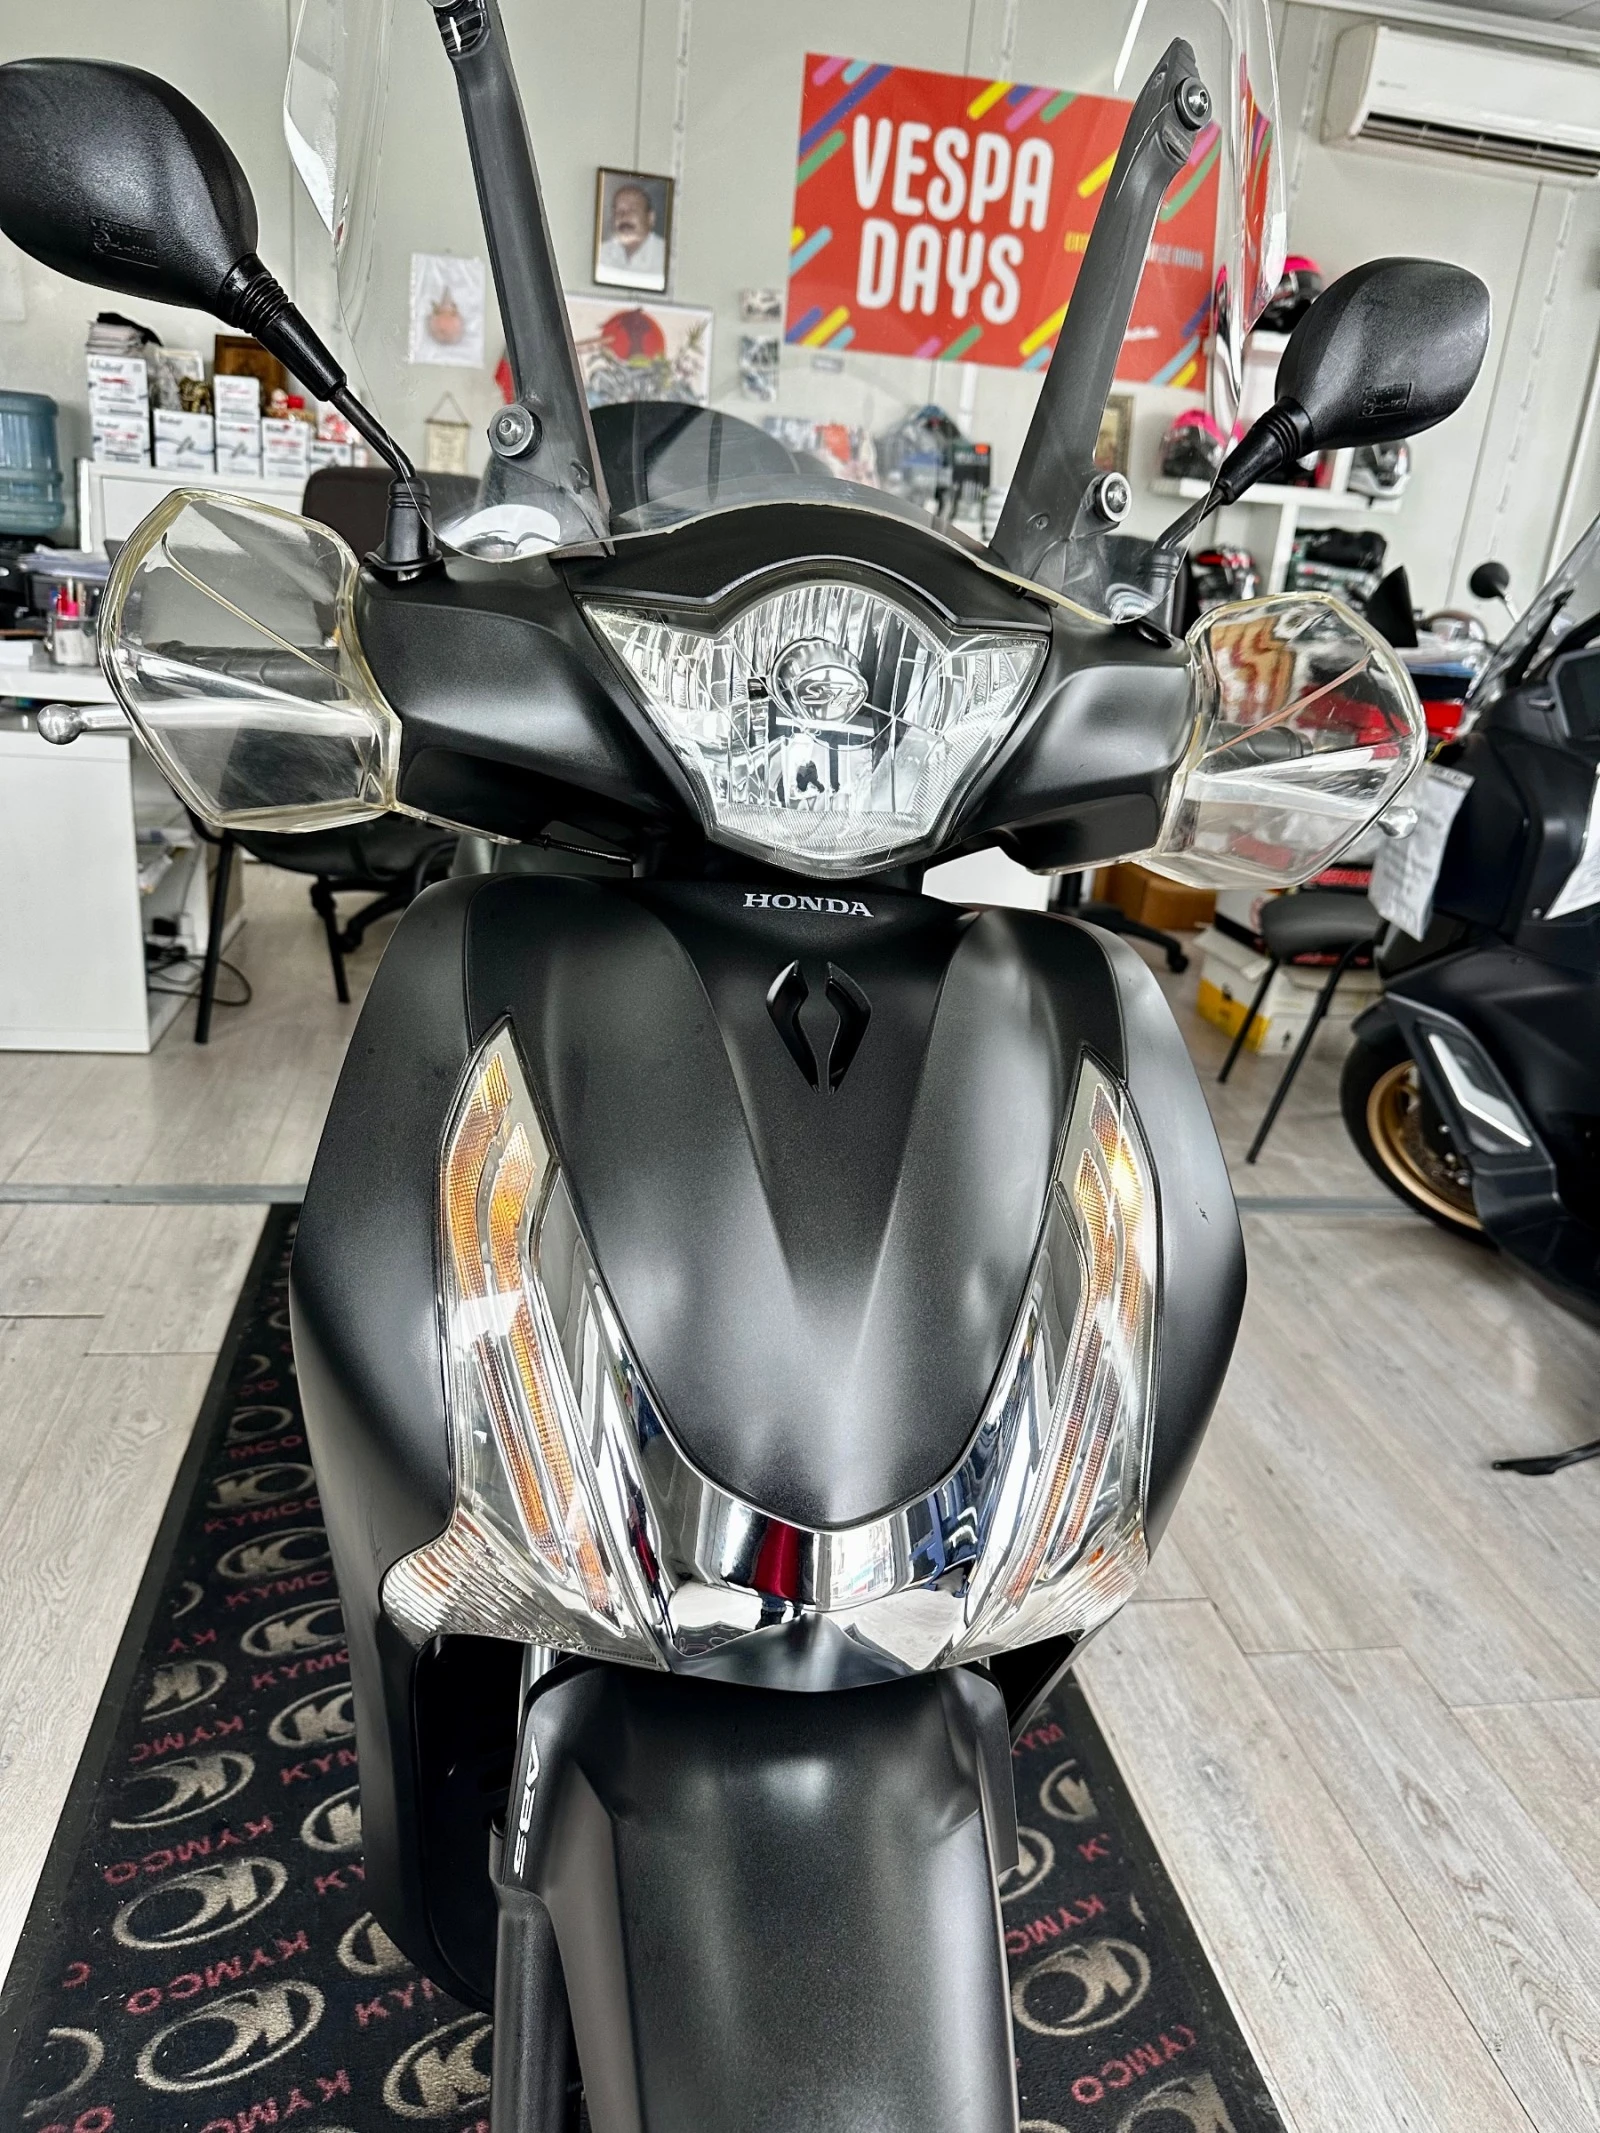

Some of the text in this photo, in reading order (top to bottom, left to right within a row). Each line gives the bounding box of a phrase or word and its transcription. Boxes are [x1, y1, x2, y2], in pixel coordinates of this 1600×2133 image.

[853, 114, 1054, 232] VESPA
[856, 216, 1024, 325] DAYS
[742, 893, 874, 918] HONDA
[103, 1815, 274, 1886] KYMCO
[513, 1734, 540, 1881] ABS
[125, 1930, 311, 2016] KYMCO
